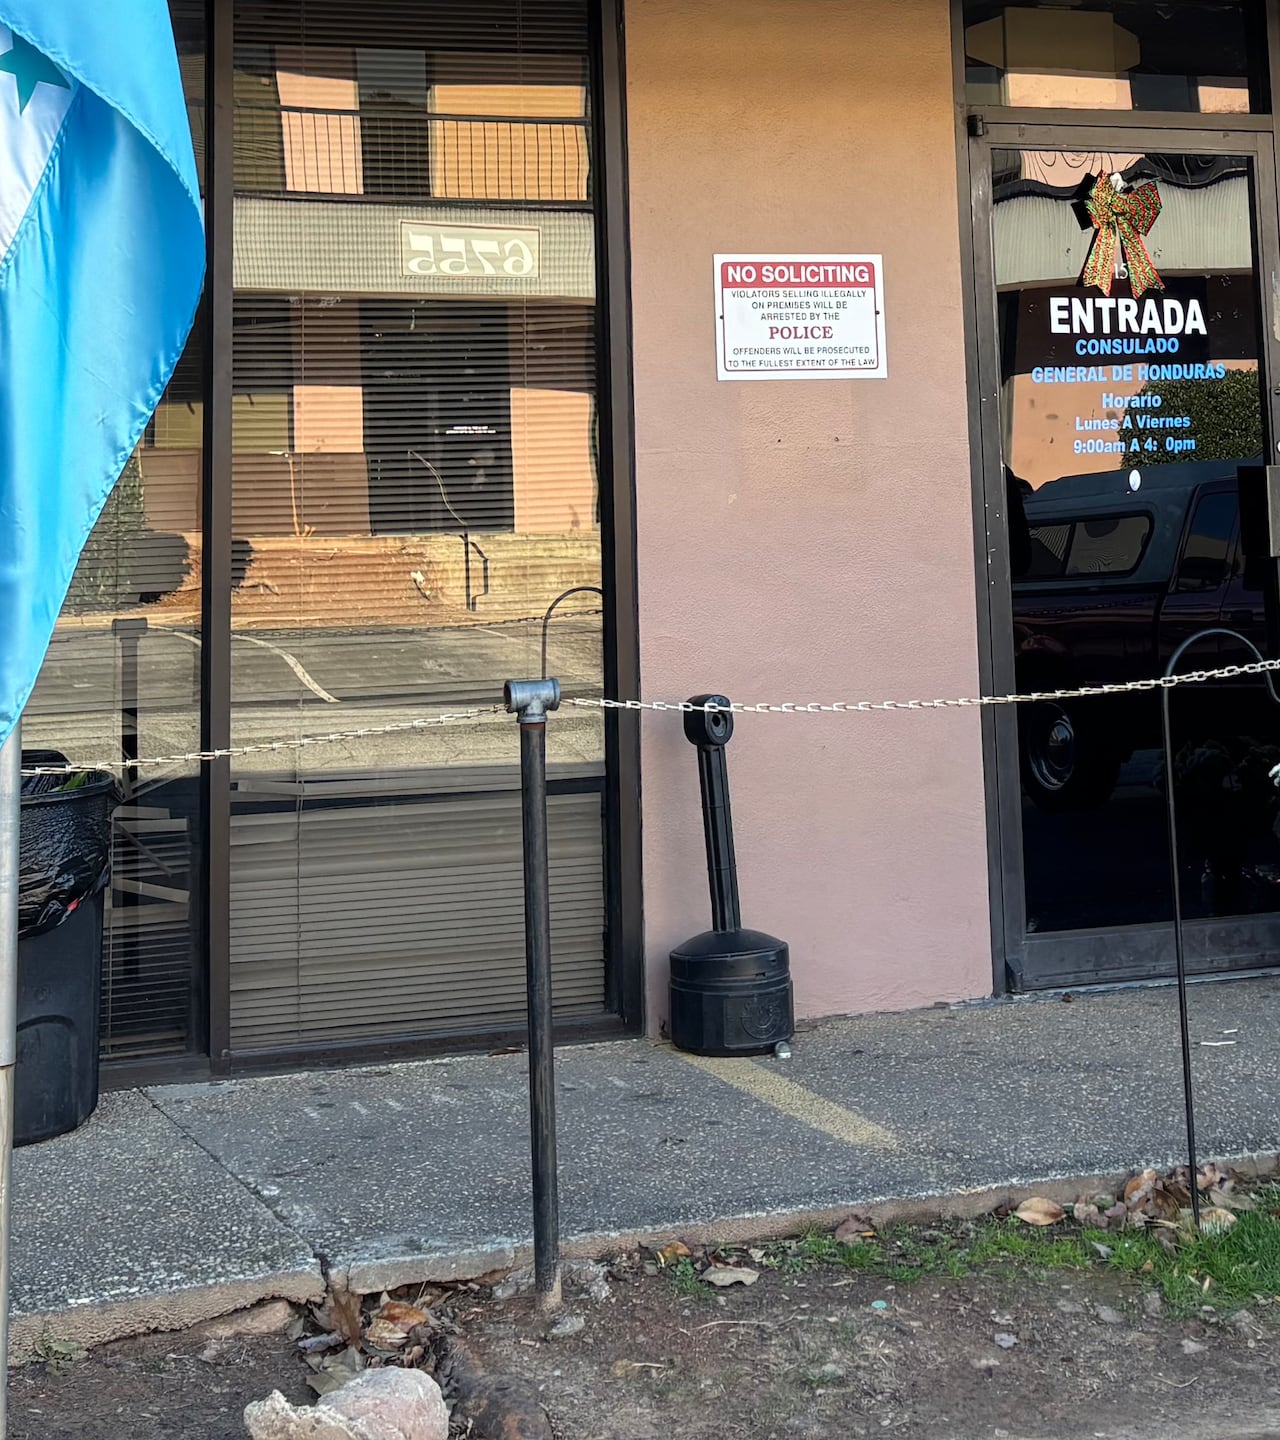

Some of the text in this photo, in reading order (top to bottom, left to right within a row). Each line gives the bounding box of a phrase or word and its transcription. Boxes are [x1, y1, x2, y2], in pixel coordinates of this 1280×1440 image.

[728, 265, 869, 283] NO SOLICITING
[731, 290, 866, 298] VIOLATORS SELLING ILLEGALLY
[752, 301, 848, 309] ON PREMISES WILL BE
[761, 312, 840, 320] ARRESTED BY THE
[1049, 297, 1208, 335] ENTRADA
[768, 326, 833, 339] POLICE
[733, 347, 781, 355] OFFENDERS
[783, 347, 802, 355] WILL
[817, 346, 870, 354] PROSECUTED
[1075, 337, 1179, 356] CONSULADO
[796, 359, 826, 367] EXTENT
[1031, 363, 1226, 384] GENERAL DE HONDURAS
[1102, 392, 1162, 409] Horario
[1075, 414, 1191, 431] Lunes A Viernes
[1073, 439, 1125, 454] 9:00am
[1130, 438, 1140, 452] A
